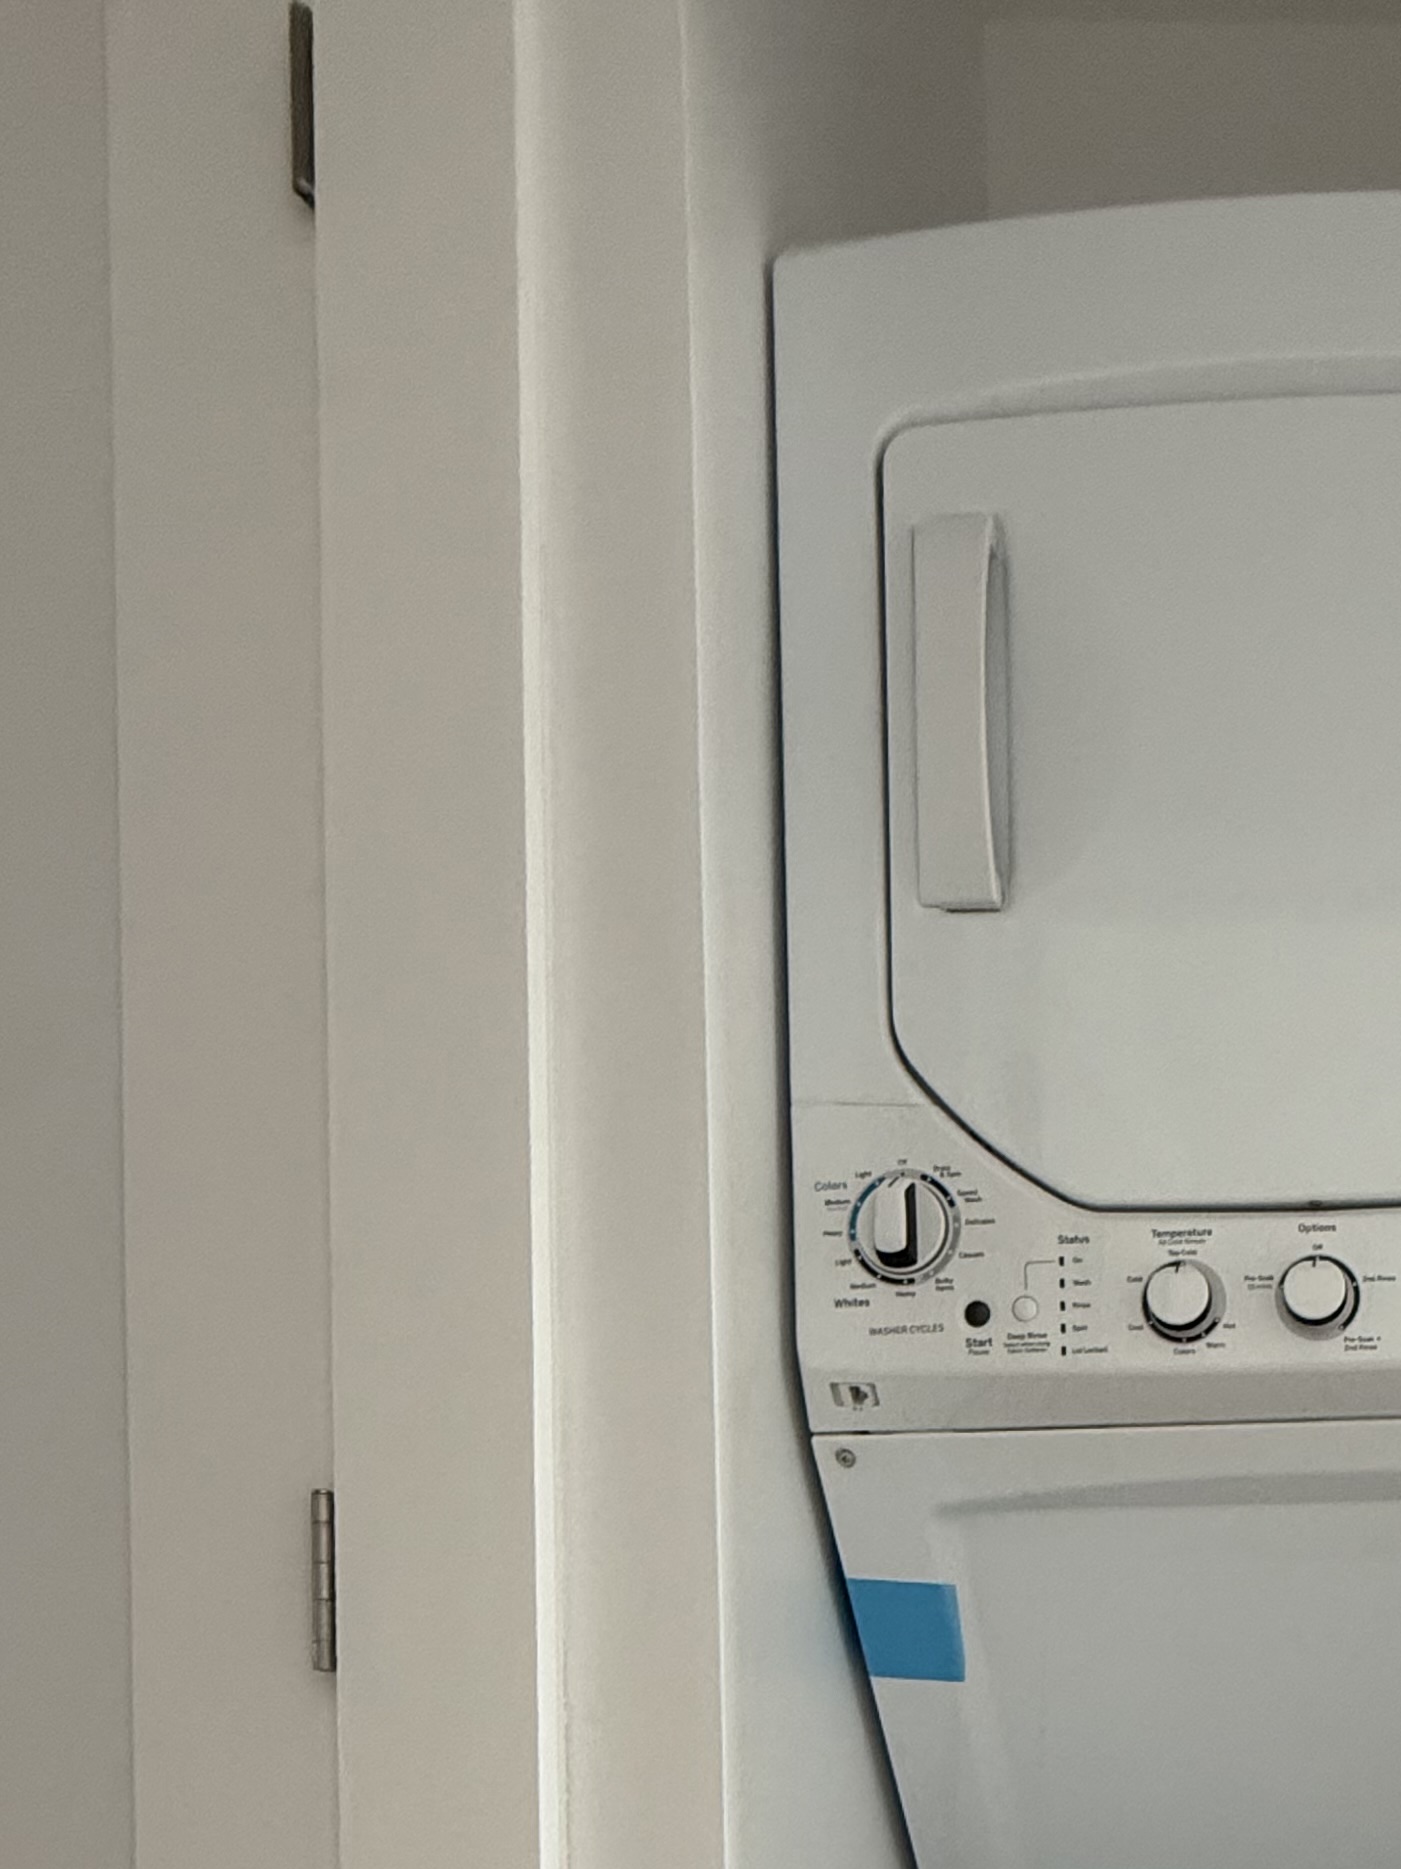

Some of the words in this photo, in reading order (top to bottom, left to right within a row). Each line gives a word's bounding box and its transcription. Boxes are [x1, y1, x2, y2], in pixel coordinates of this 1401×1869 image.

[814, 1180, 847, 1192] Colors
[1151, 1228, 1213, 1239] Temperature
[1298, 1223, 1336, 1235] Options
[1058, 1234, 1090, 1245] Status
[834, 1298, 870, 1308] Whites
[868, 1325, 907, 1336] WASHER
[909, 1323, 944, 1334] CYCLES
[965, 1337, 992, 1348] Start
